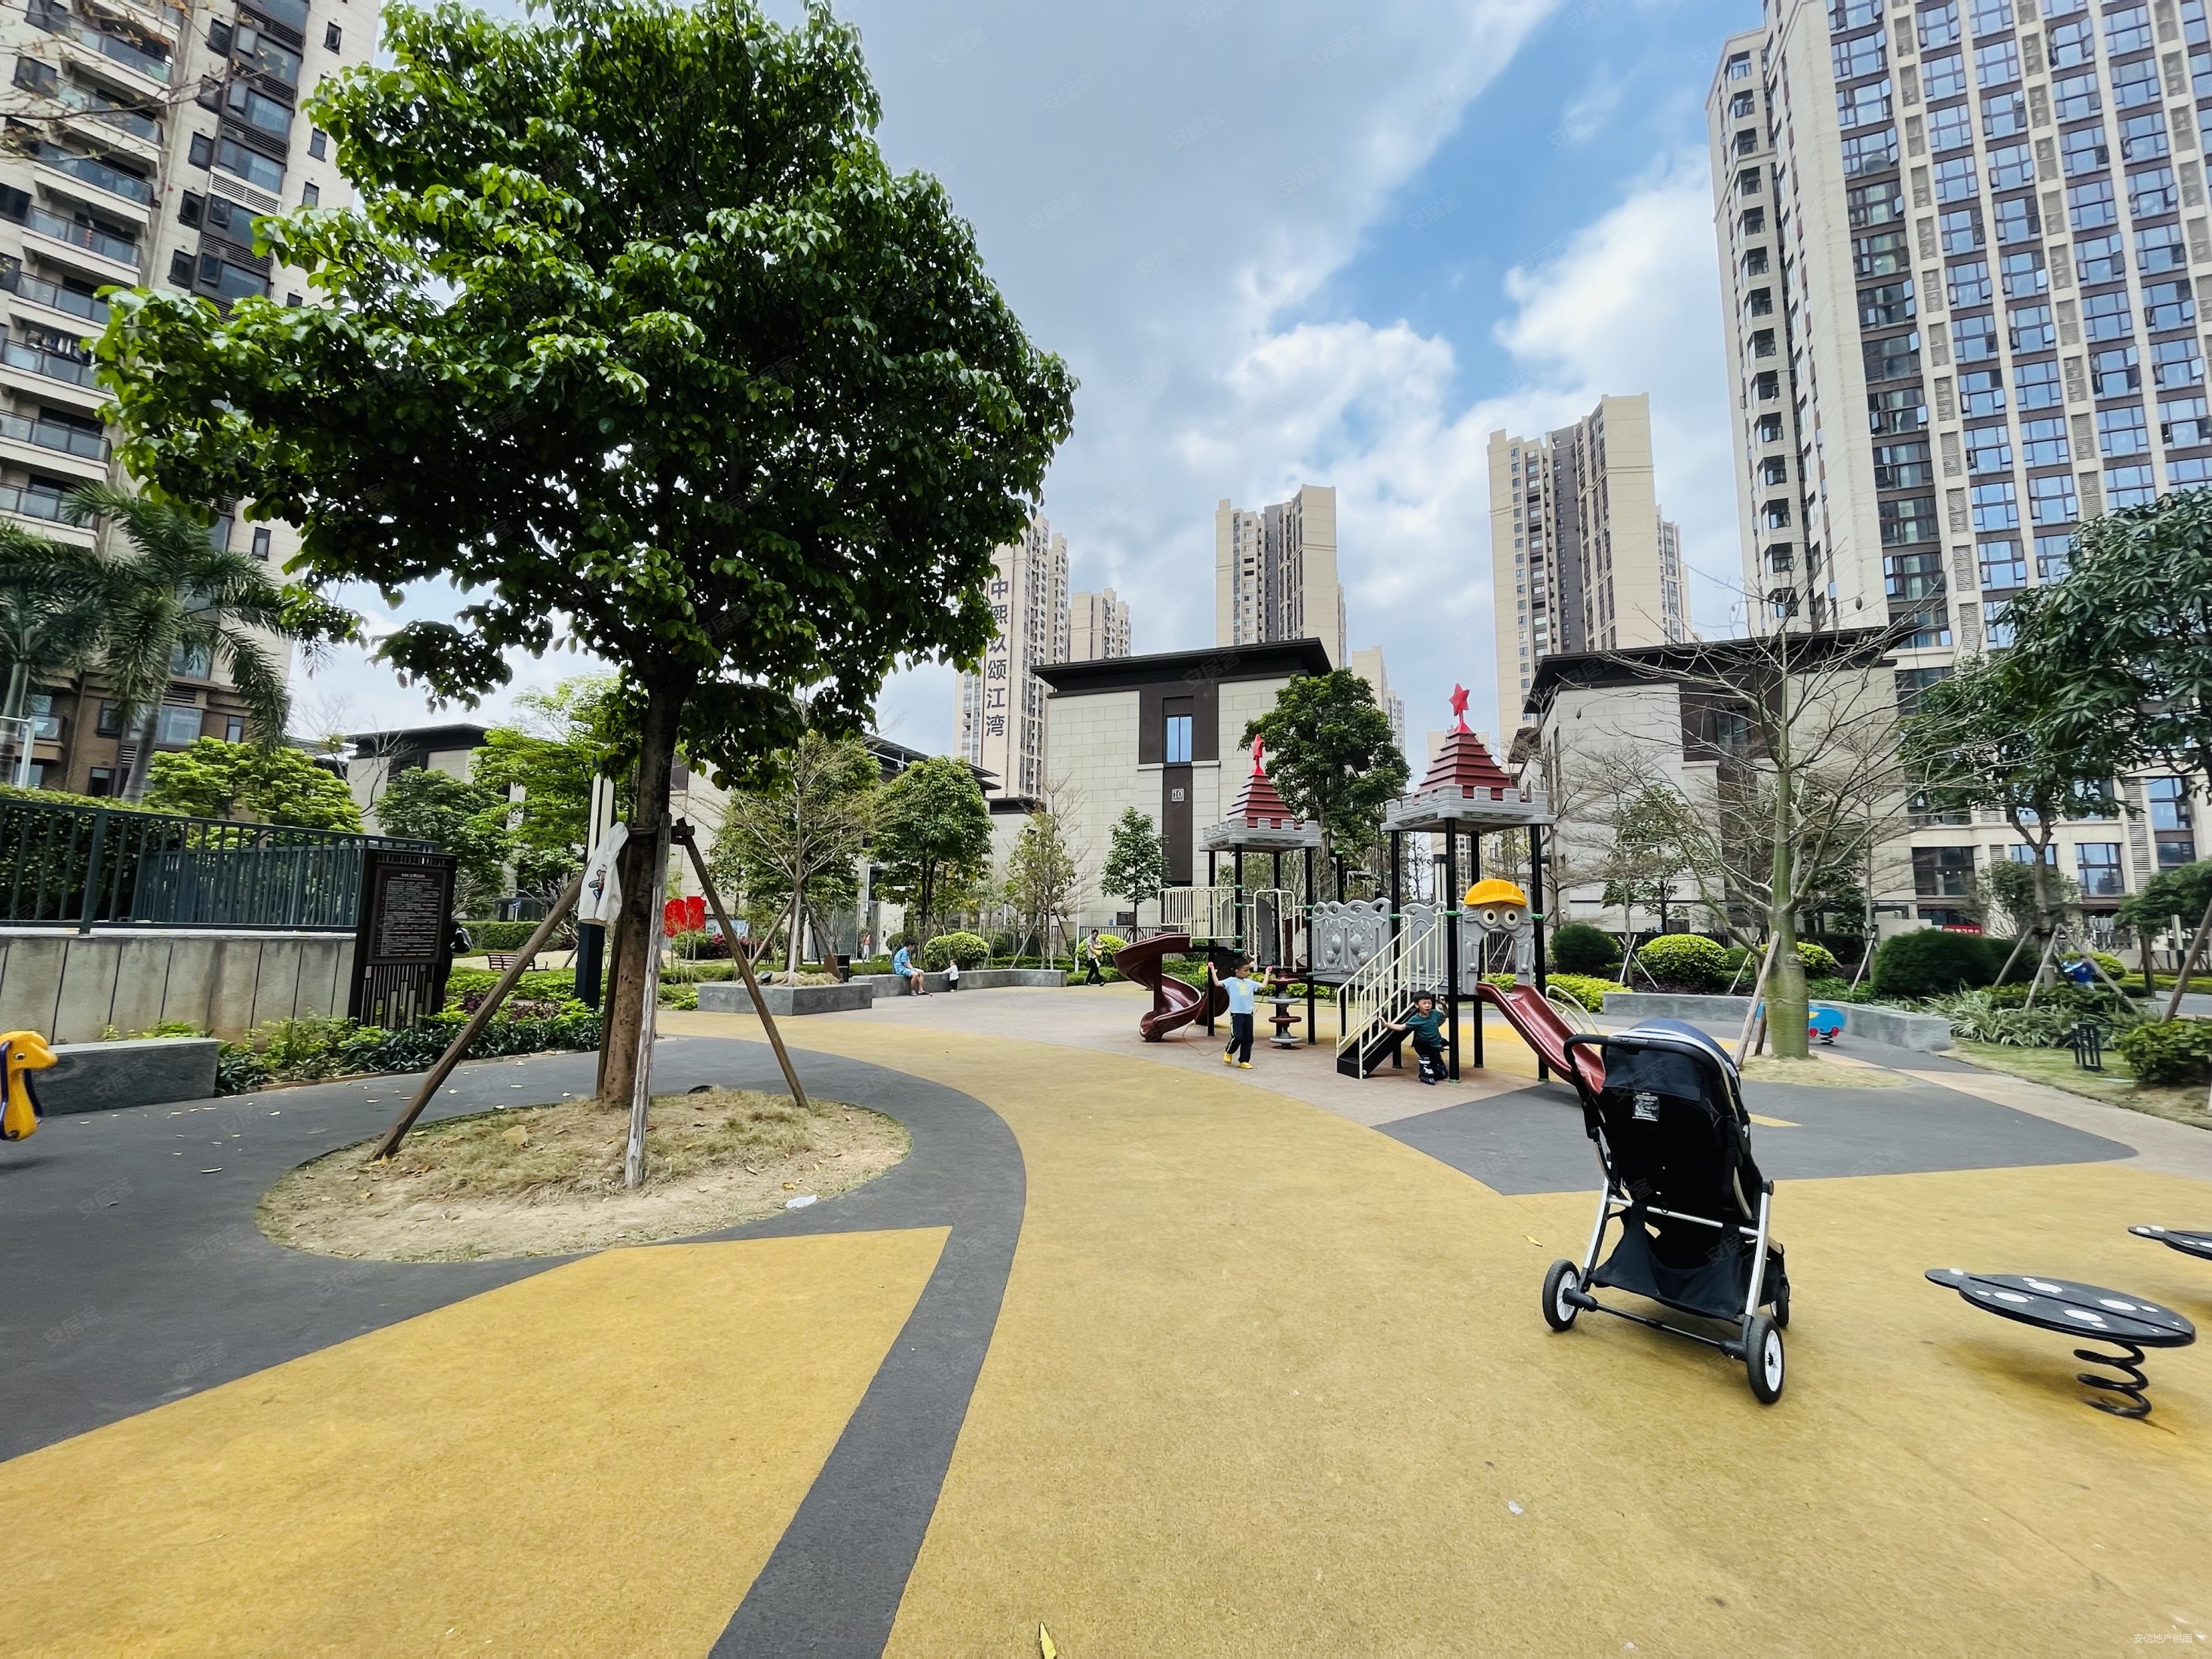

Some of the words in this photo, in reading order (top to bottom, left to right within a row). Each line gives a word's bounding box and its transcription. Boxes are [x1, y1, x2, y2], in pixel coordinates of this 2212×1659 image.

[986, 578, 1008, 737] 中熙玖颂江湾
[1173, 790, 1183, 799] 10
